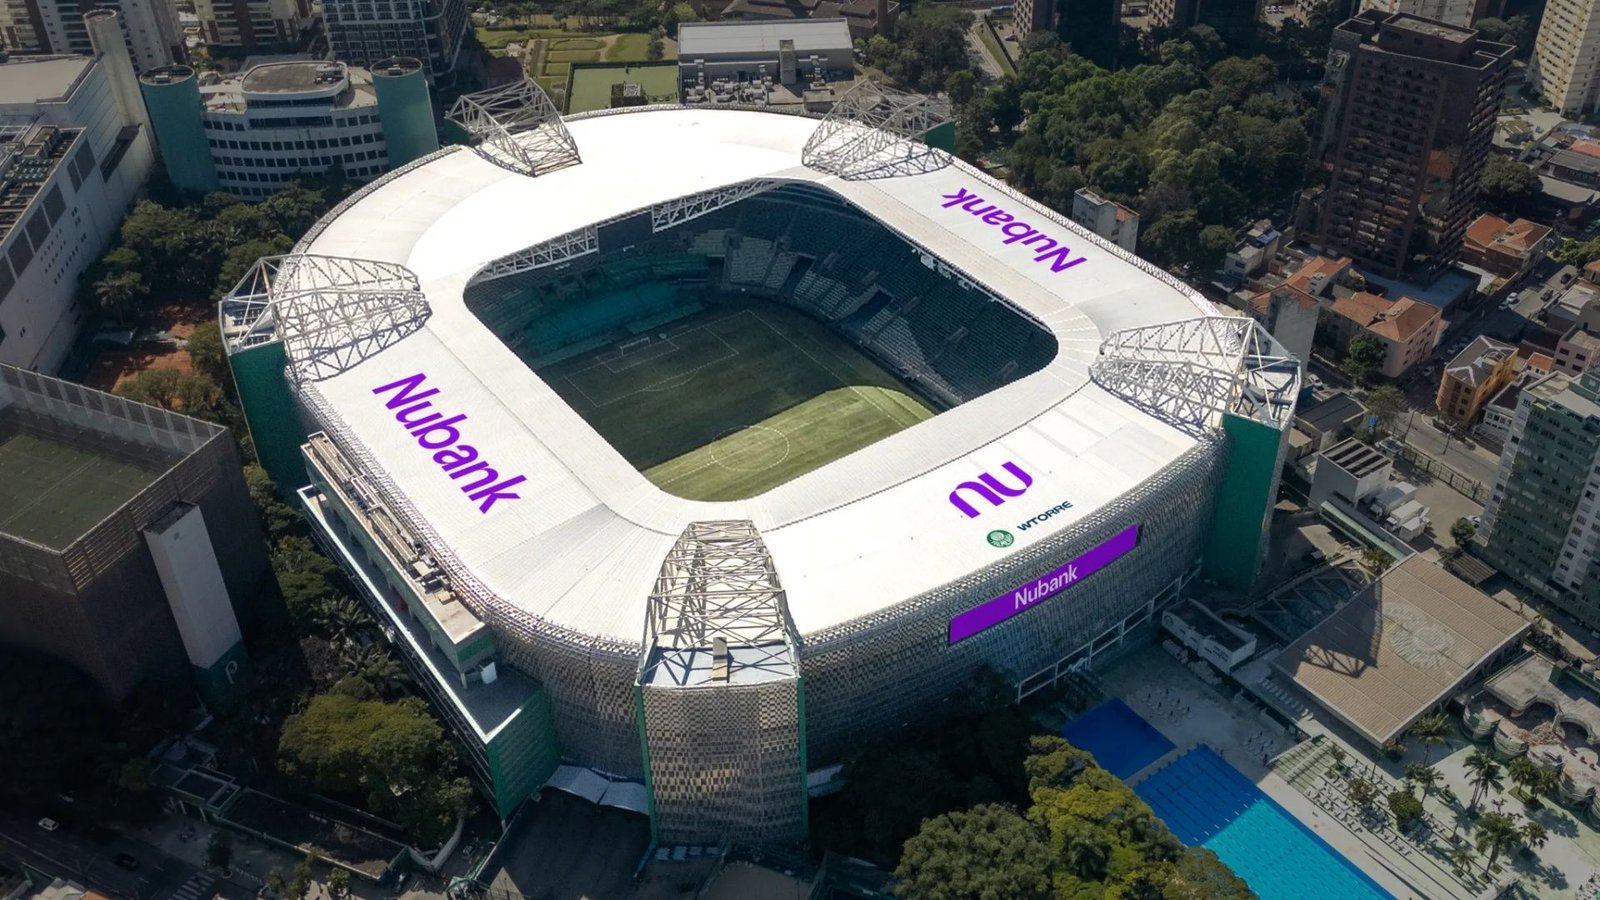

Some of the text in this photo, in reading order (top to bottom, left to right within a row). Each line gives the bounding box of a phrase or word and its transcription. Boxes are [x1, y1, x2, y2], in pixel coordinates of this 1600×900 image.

[941, 187, 1088, 273] Nubank
[371, 372, 528, 514] Nubank
[1016, 500, 1074, 531] WTORRE
[1014, 564, 1079, 610] Nubank
